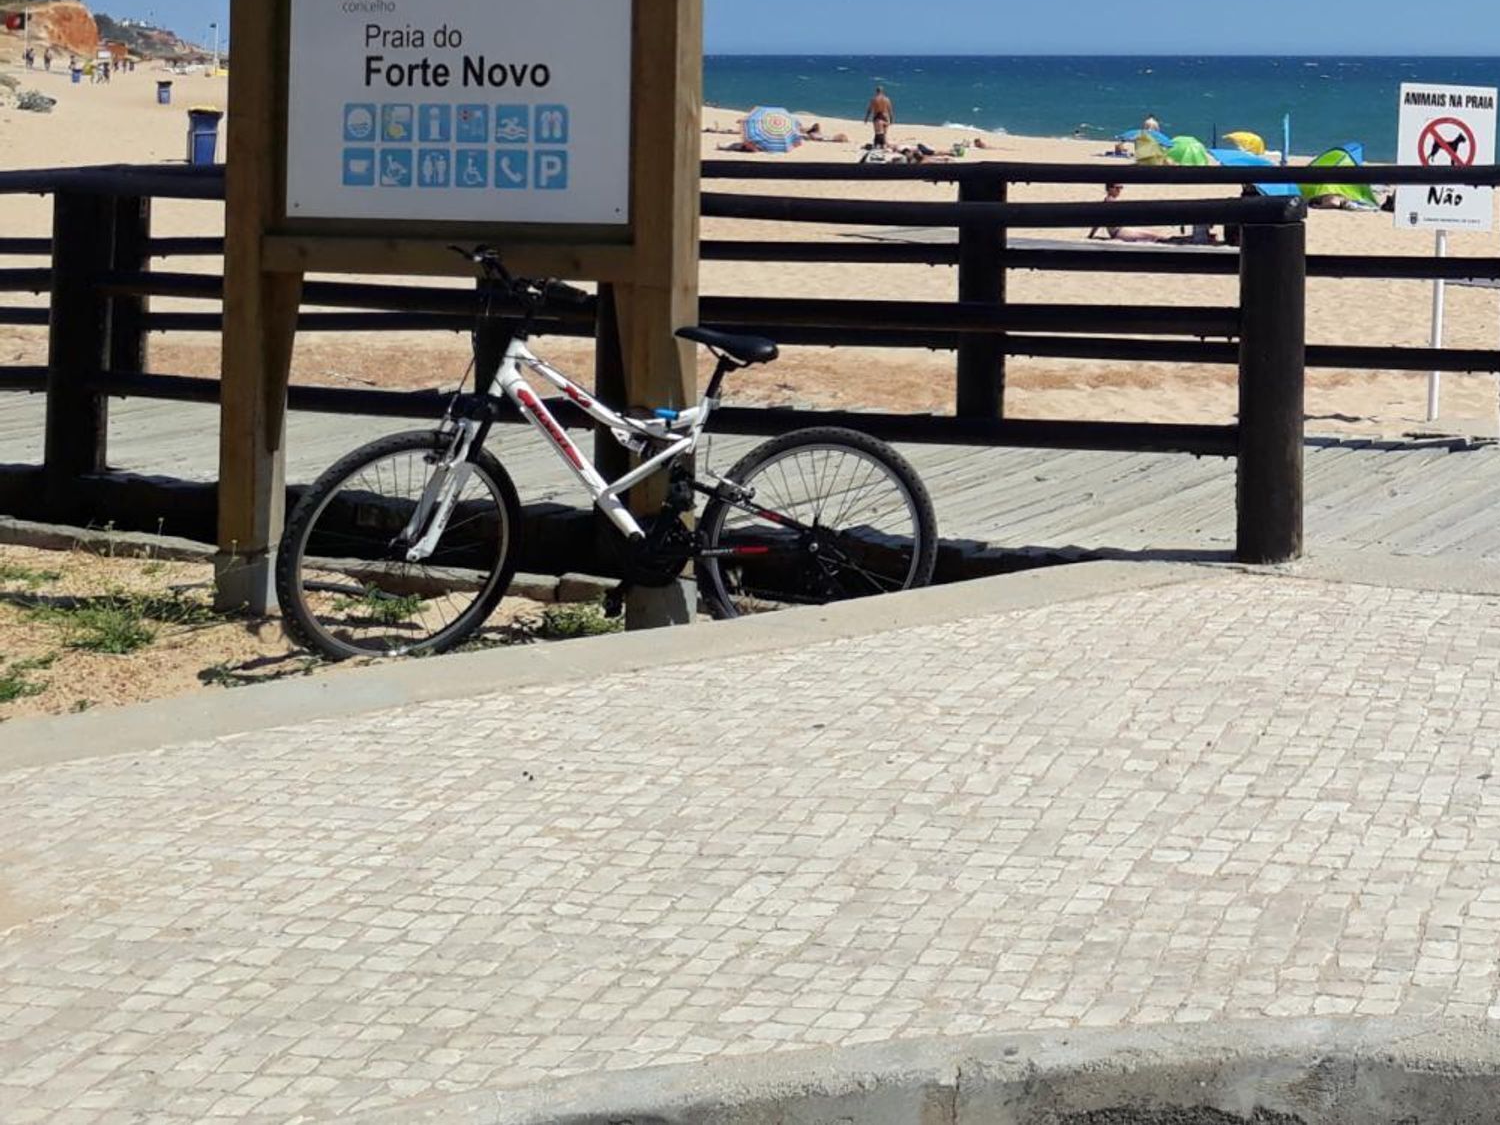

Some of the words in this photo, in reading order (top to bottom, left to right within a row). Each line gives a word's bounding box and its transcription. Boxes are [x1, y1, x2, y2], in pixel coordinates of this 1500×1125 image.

[365, 23, 425, 48] Praia
[433, 23, 462, 48] do
[365, 55, 450, 87] Forte
[462, 55, 551, 87] Novo
[1404, 91, 1447, 107] ANIMAIS
[1449, 93, 1463, 108] NA
[1465, 94, 1494, 110] PRAIA
[540, 155, 563, 187] P
[1427, 186, 1463, 206] Não
